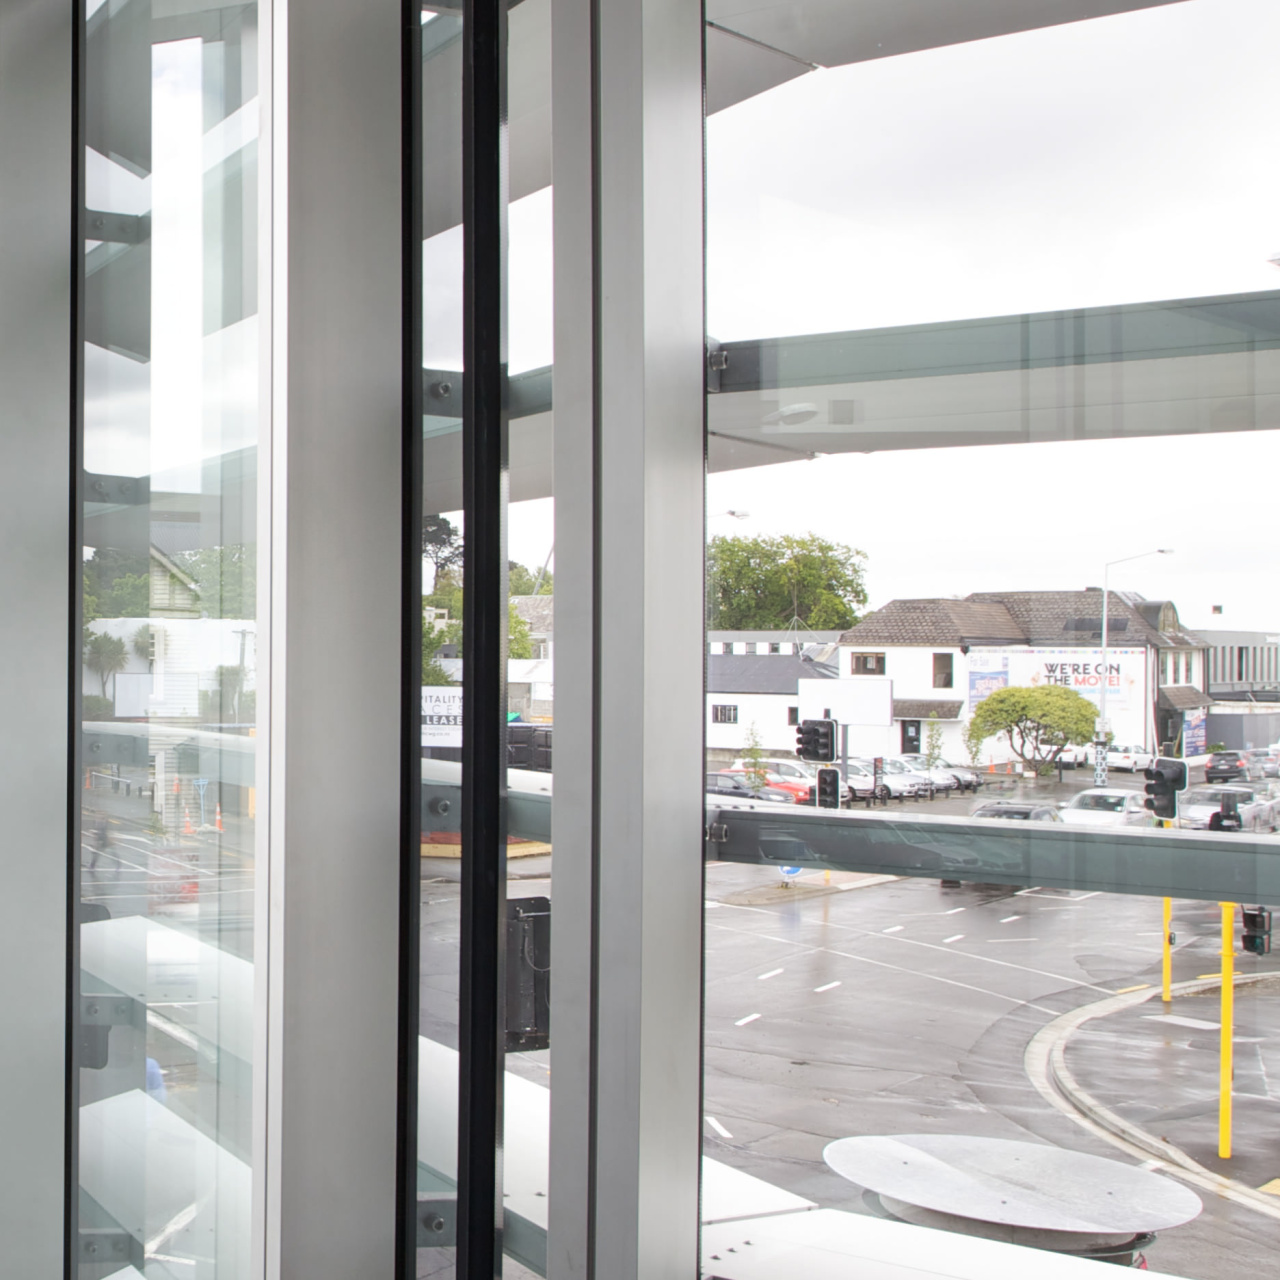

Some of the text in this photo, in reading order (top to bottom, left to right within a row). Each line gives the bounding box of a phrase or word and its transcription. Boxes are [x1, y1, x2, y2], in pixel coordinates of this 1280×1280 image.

[1044, 663, 1120, 675] WE'RE ON
[1044, 675, 1071, 686] THE
[421, 695, 463, 703] ITALITY
[426, 715, 463, 725] LEASE
